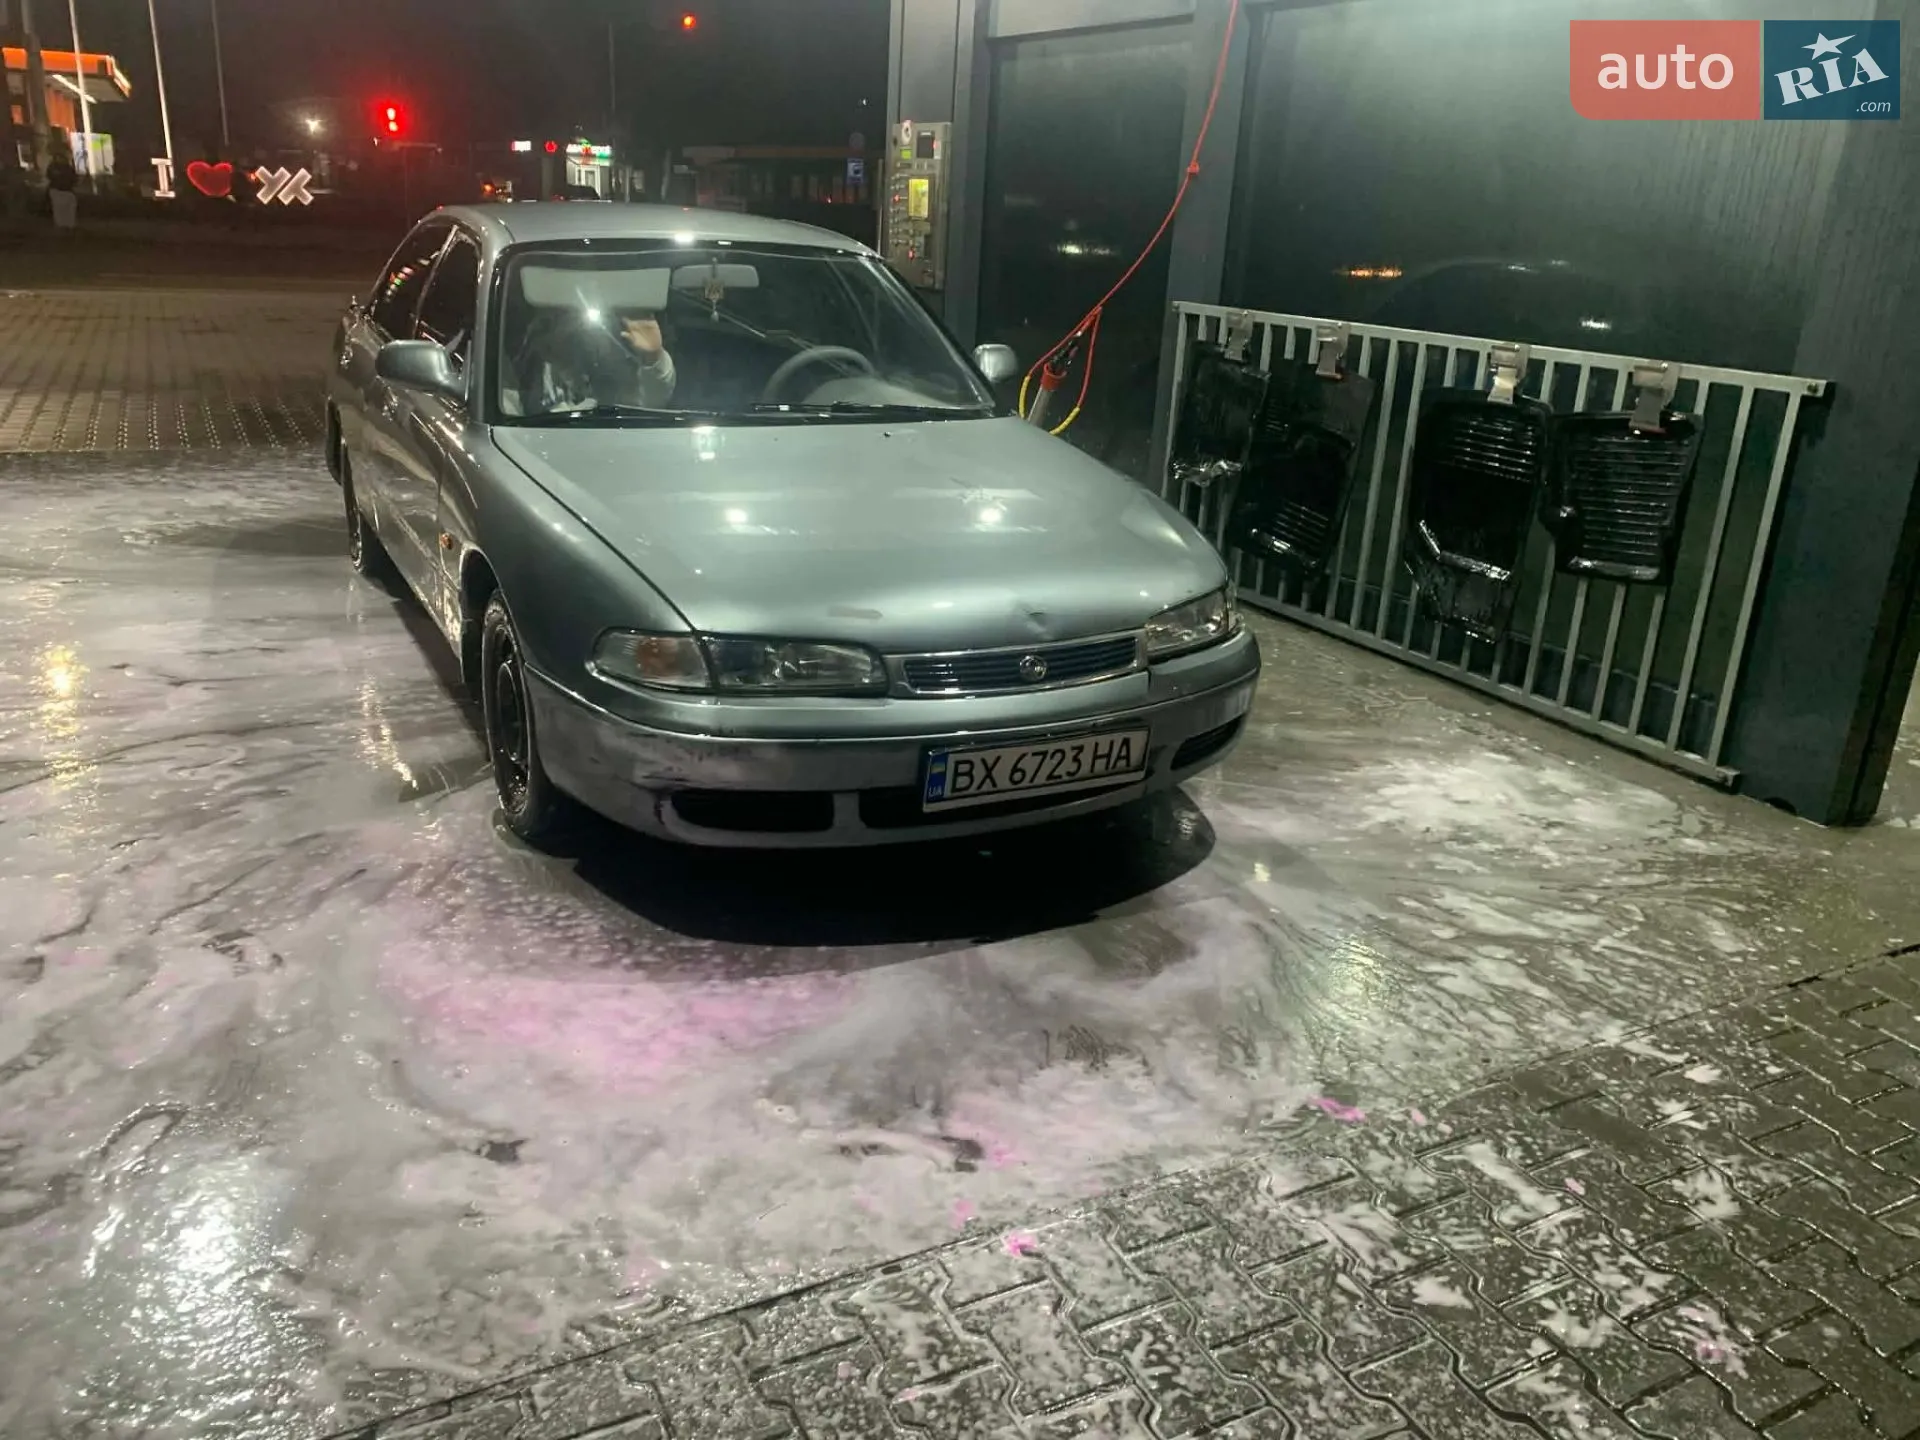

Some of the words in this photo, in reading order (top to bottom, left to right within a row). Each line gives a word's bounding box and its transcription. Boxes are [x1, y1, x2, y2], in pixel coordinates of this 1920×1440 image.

[951, 756, 1002, 793] BX
[1008, 744, 1084, 787] 6723
[1090, 737, 1132, 774] HA
